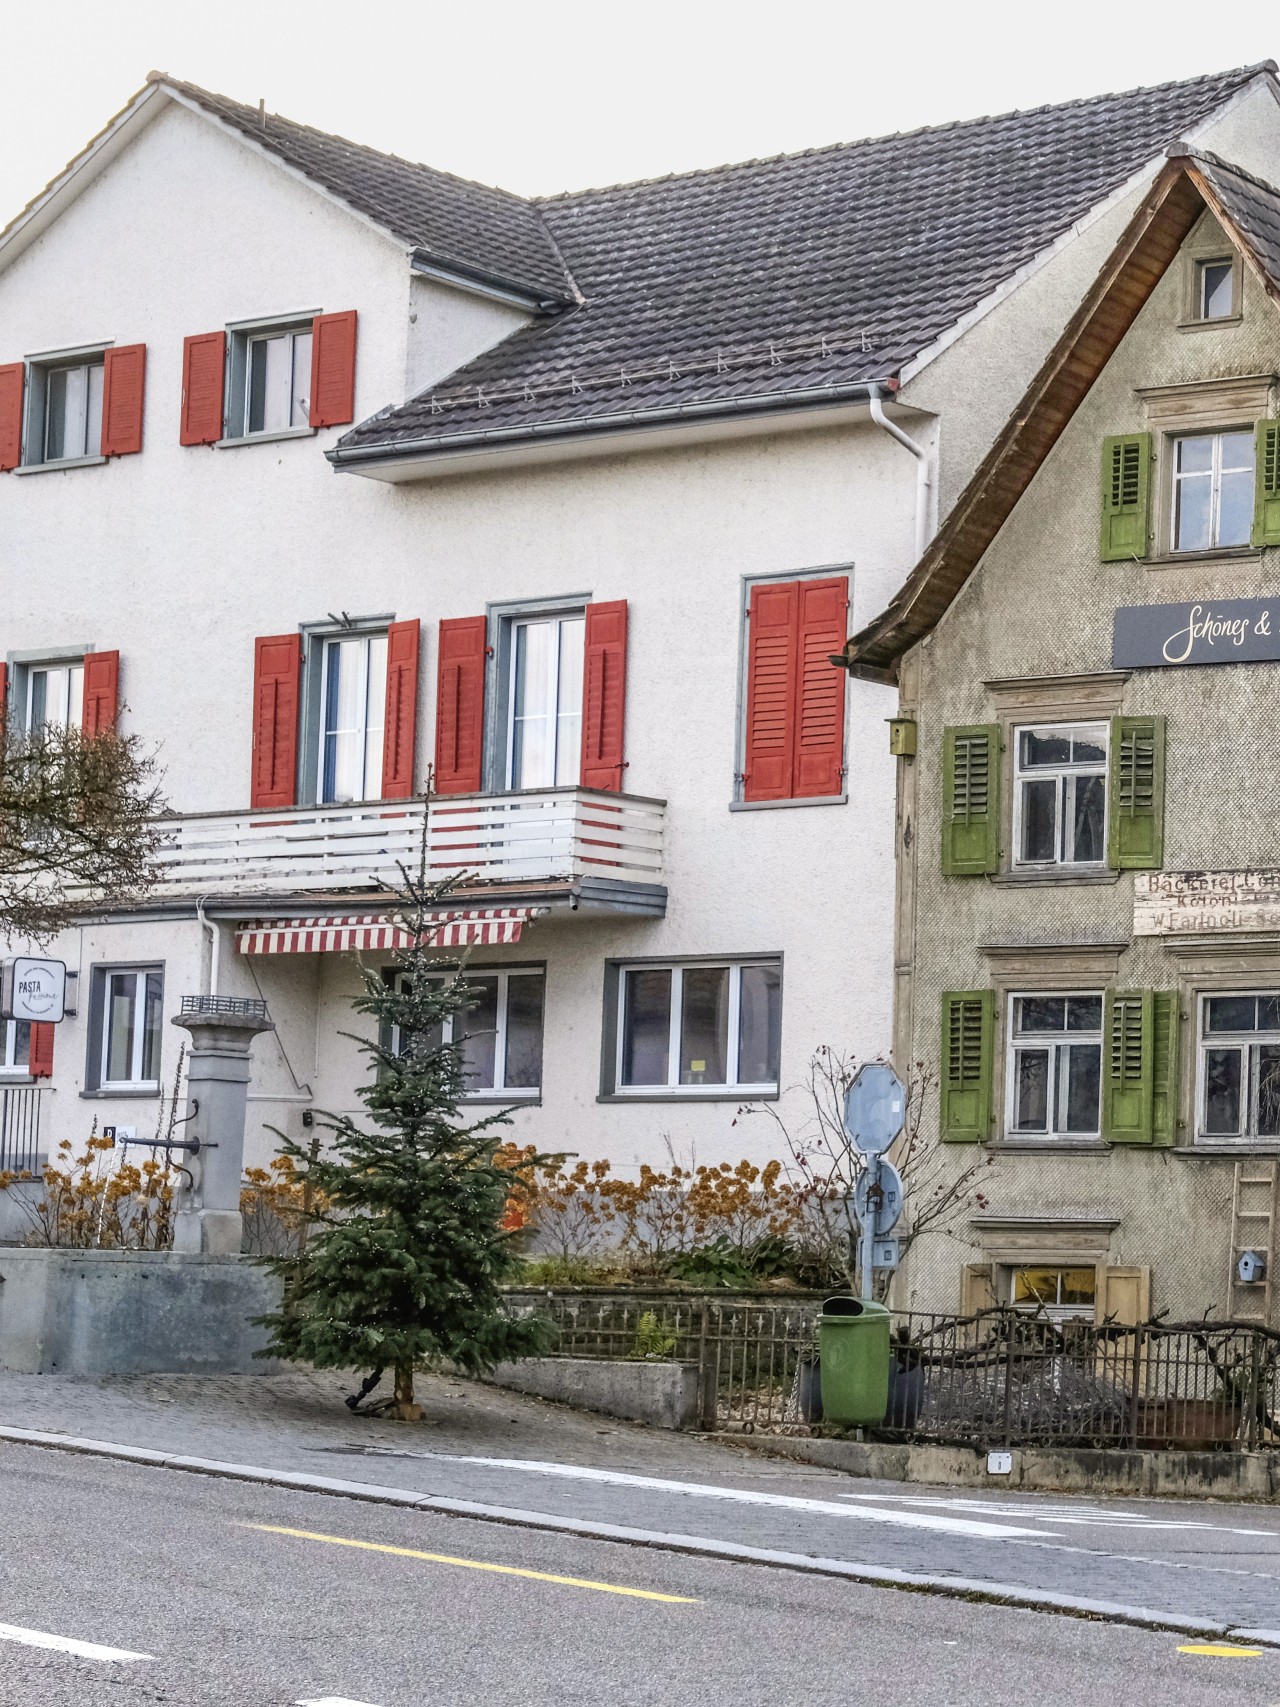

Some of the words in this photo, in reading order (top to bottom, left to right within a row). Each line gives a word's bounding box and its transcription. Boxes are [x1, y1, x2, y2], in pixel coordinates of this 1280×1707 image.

[1162, 605, 1249, 663] Schönes
[1254, 610, 1271, 636] &
[18, 980, 41, 994] PASTA
